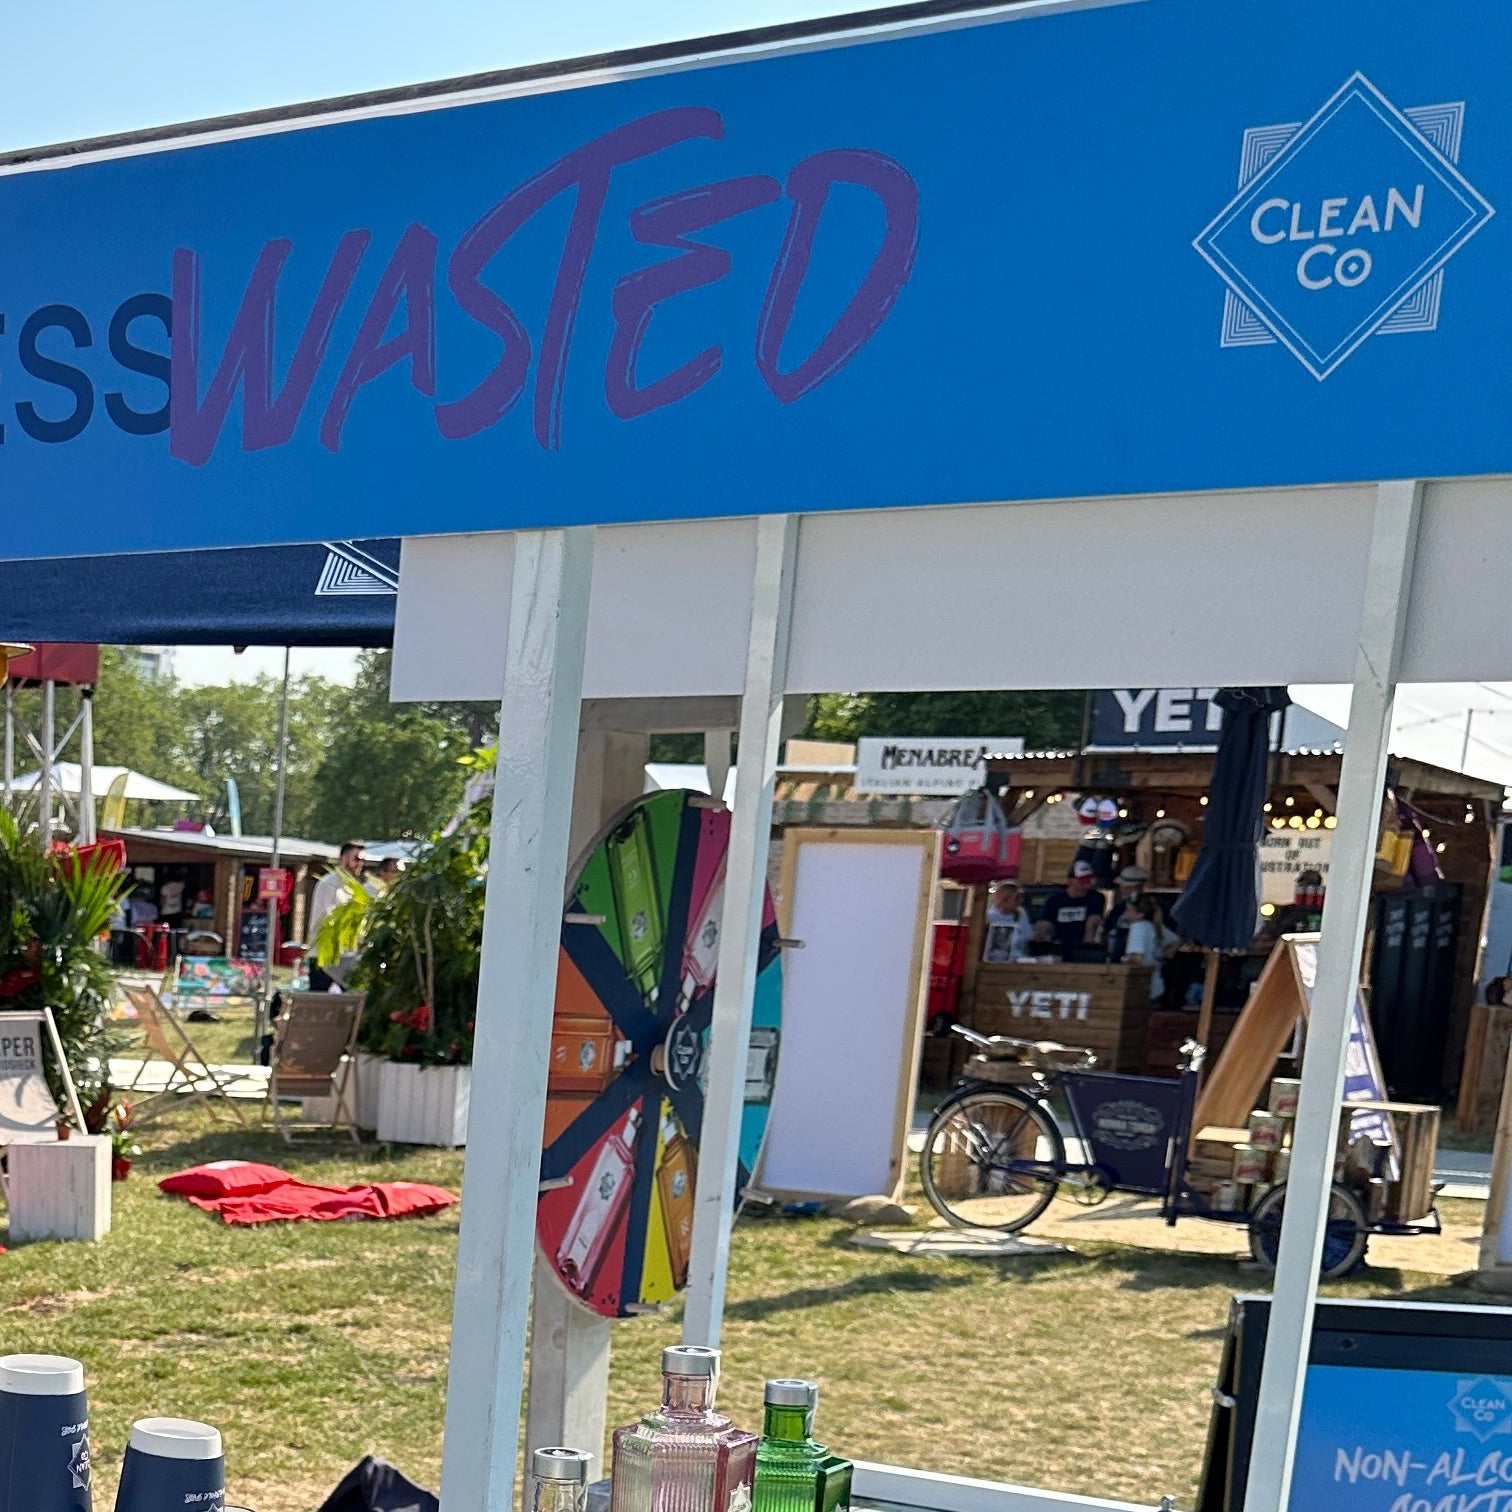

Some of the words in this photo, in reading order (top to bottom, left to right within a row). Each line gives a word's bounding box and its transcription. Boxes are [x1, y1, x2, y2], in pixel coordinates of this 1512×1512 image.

[1250, 185, 1424, 245] CLEAN
[1296, 243, 1372, 290] CO
[170, 106, 920, 467] WASTED
[881, 745, 987, 770] MENABREA
[1006, 990, 1092, 1020] YETI
[1461, 1396, 1506, 1410] CLEAN
